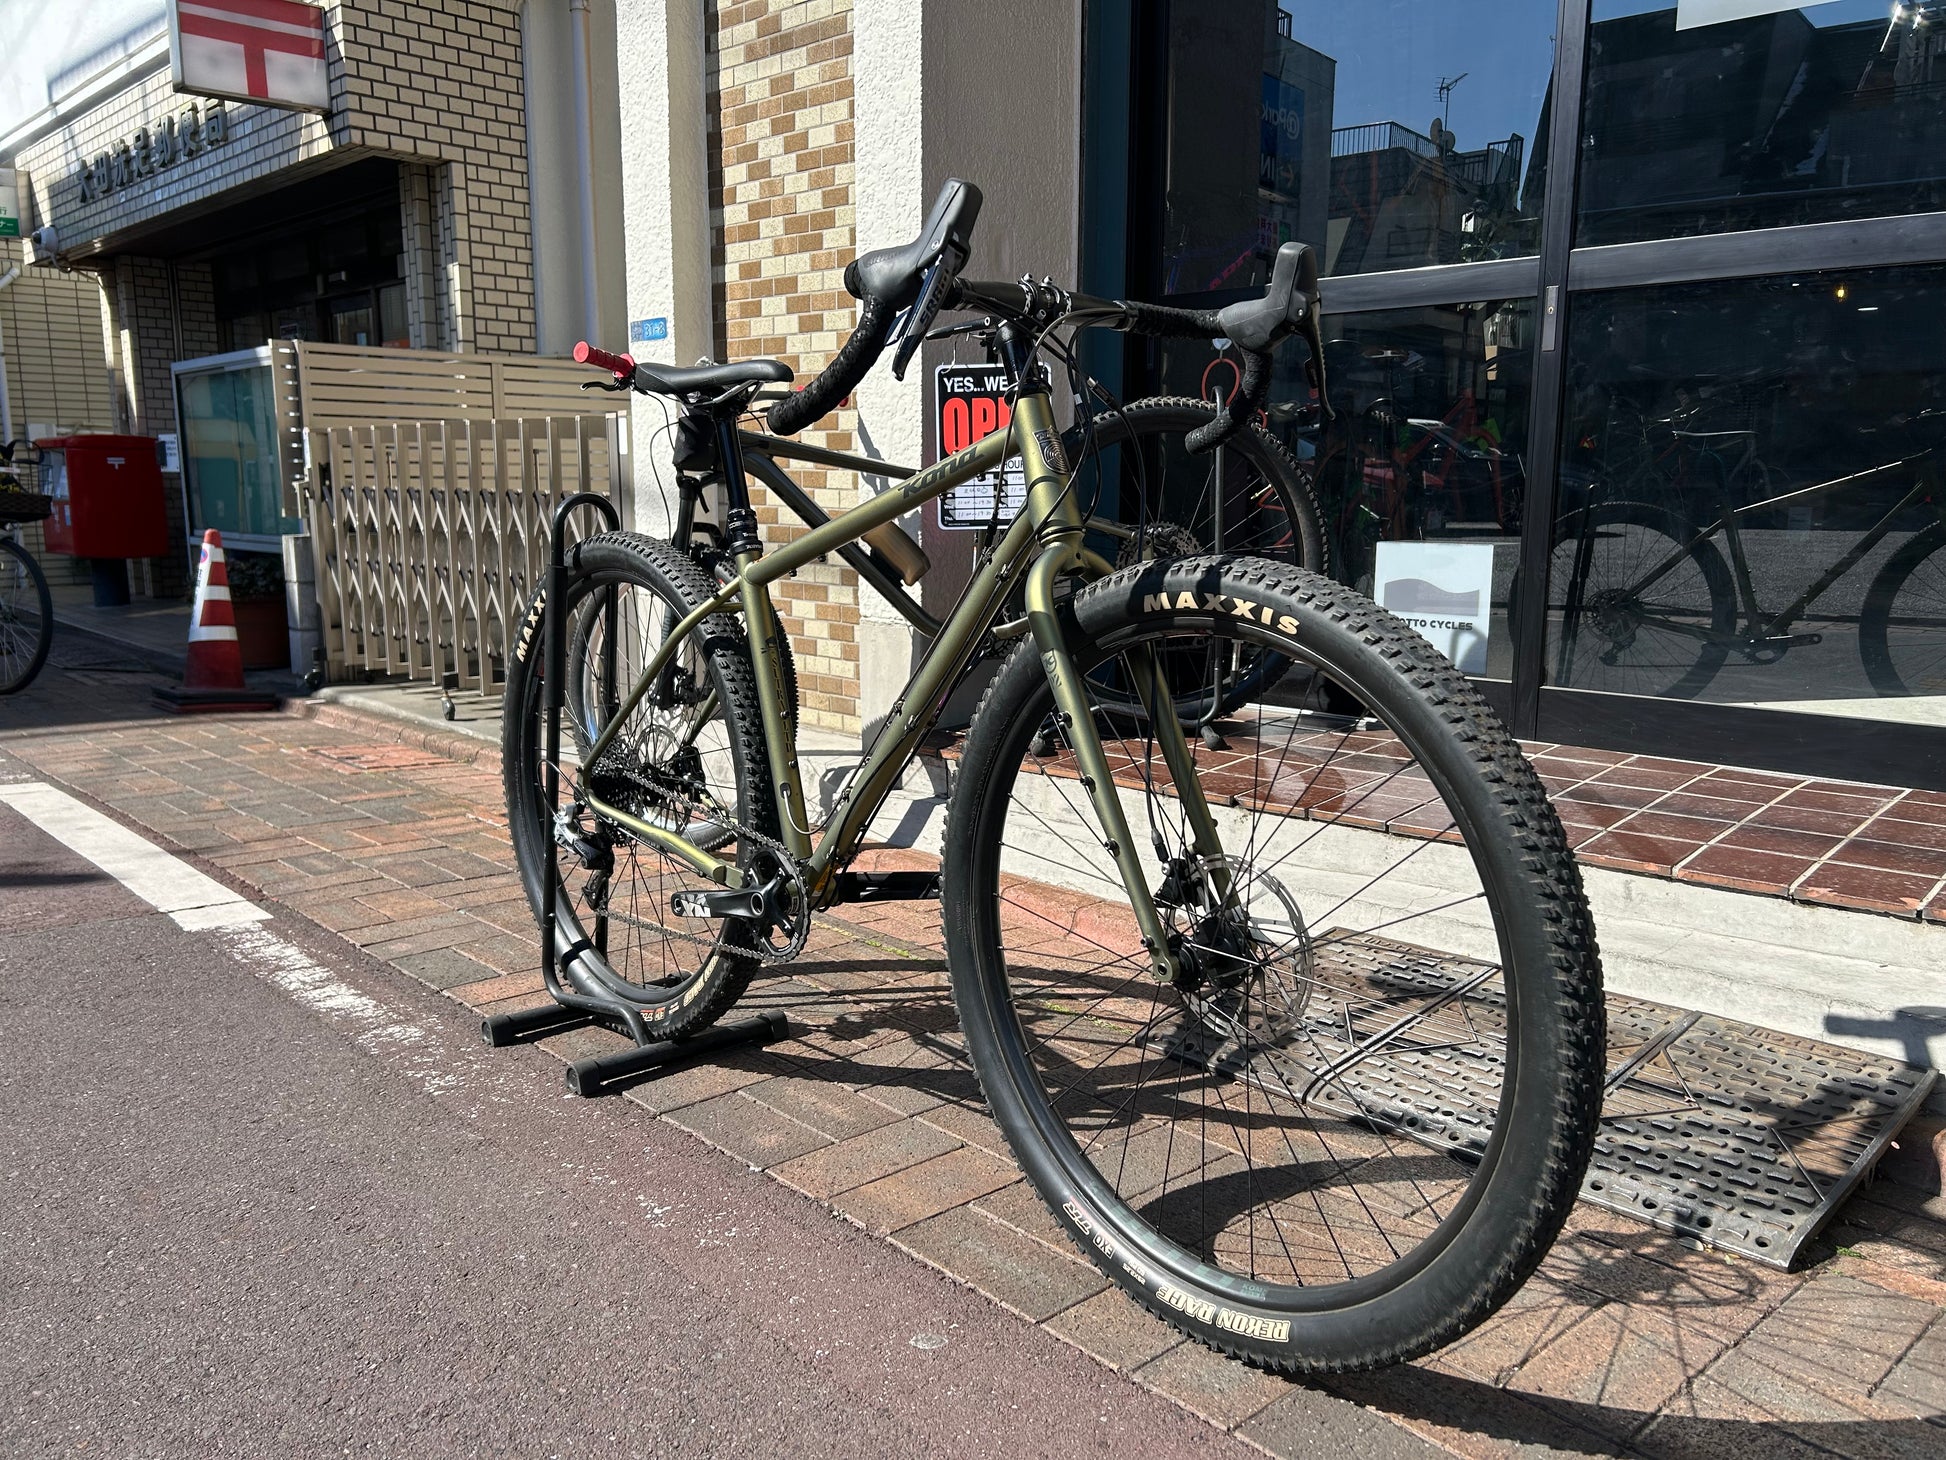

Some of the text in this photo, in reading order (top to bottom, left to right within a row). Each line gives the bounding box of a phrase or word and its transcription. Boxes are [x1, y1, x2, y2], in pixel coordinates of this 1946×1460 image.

[1143, 591, 1300, 635] MAXXIS
[1430, 620, 1473, 631] CYCLES
[1063, 1200, 1093, 1235] TR
[1092, 1230, 1116, 1259] EXO
[1155, 1282, 1291, 1343] REKON RACE
